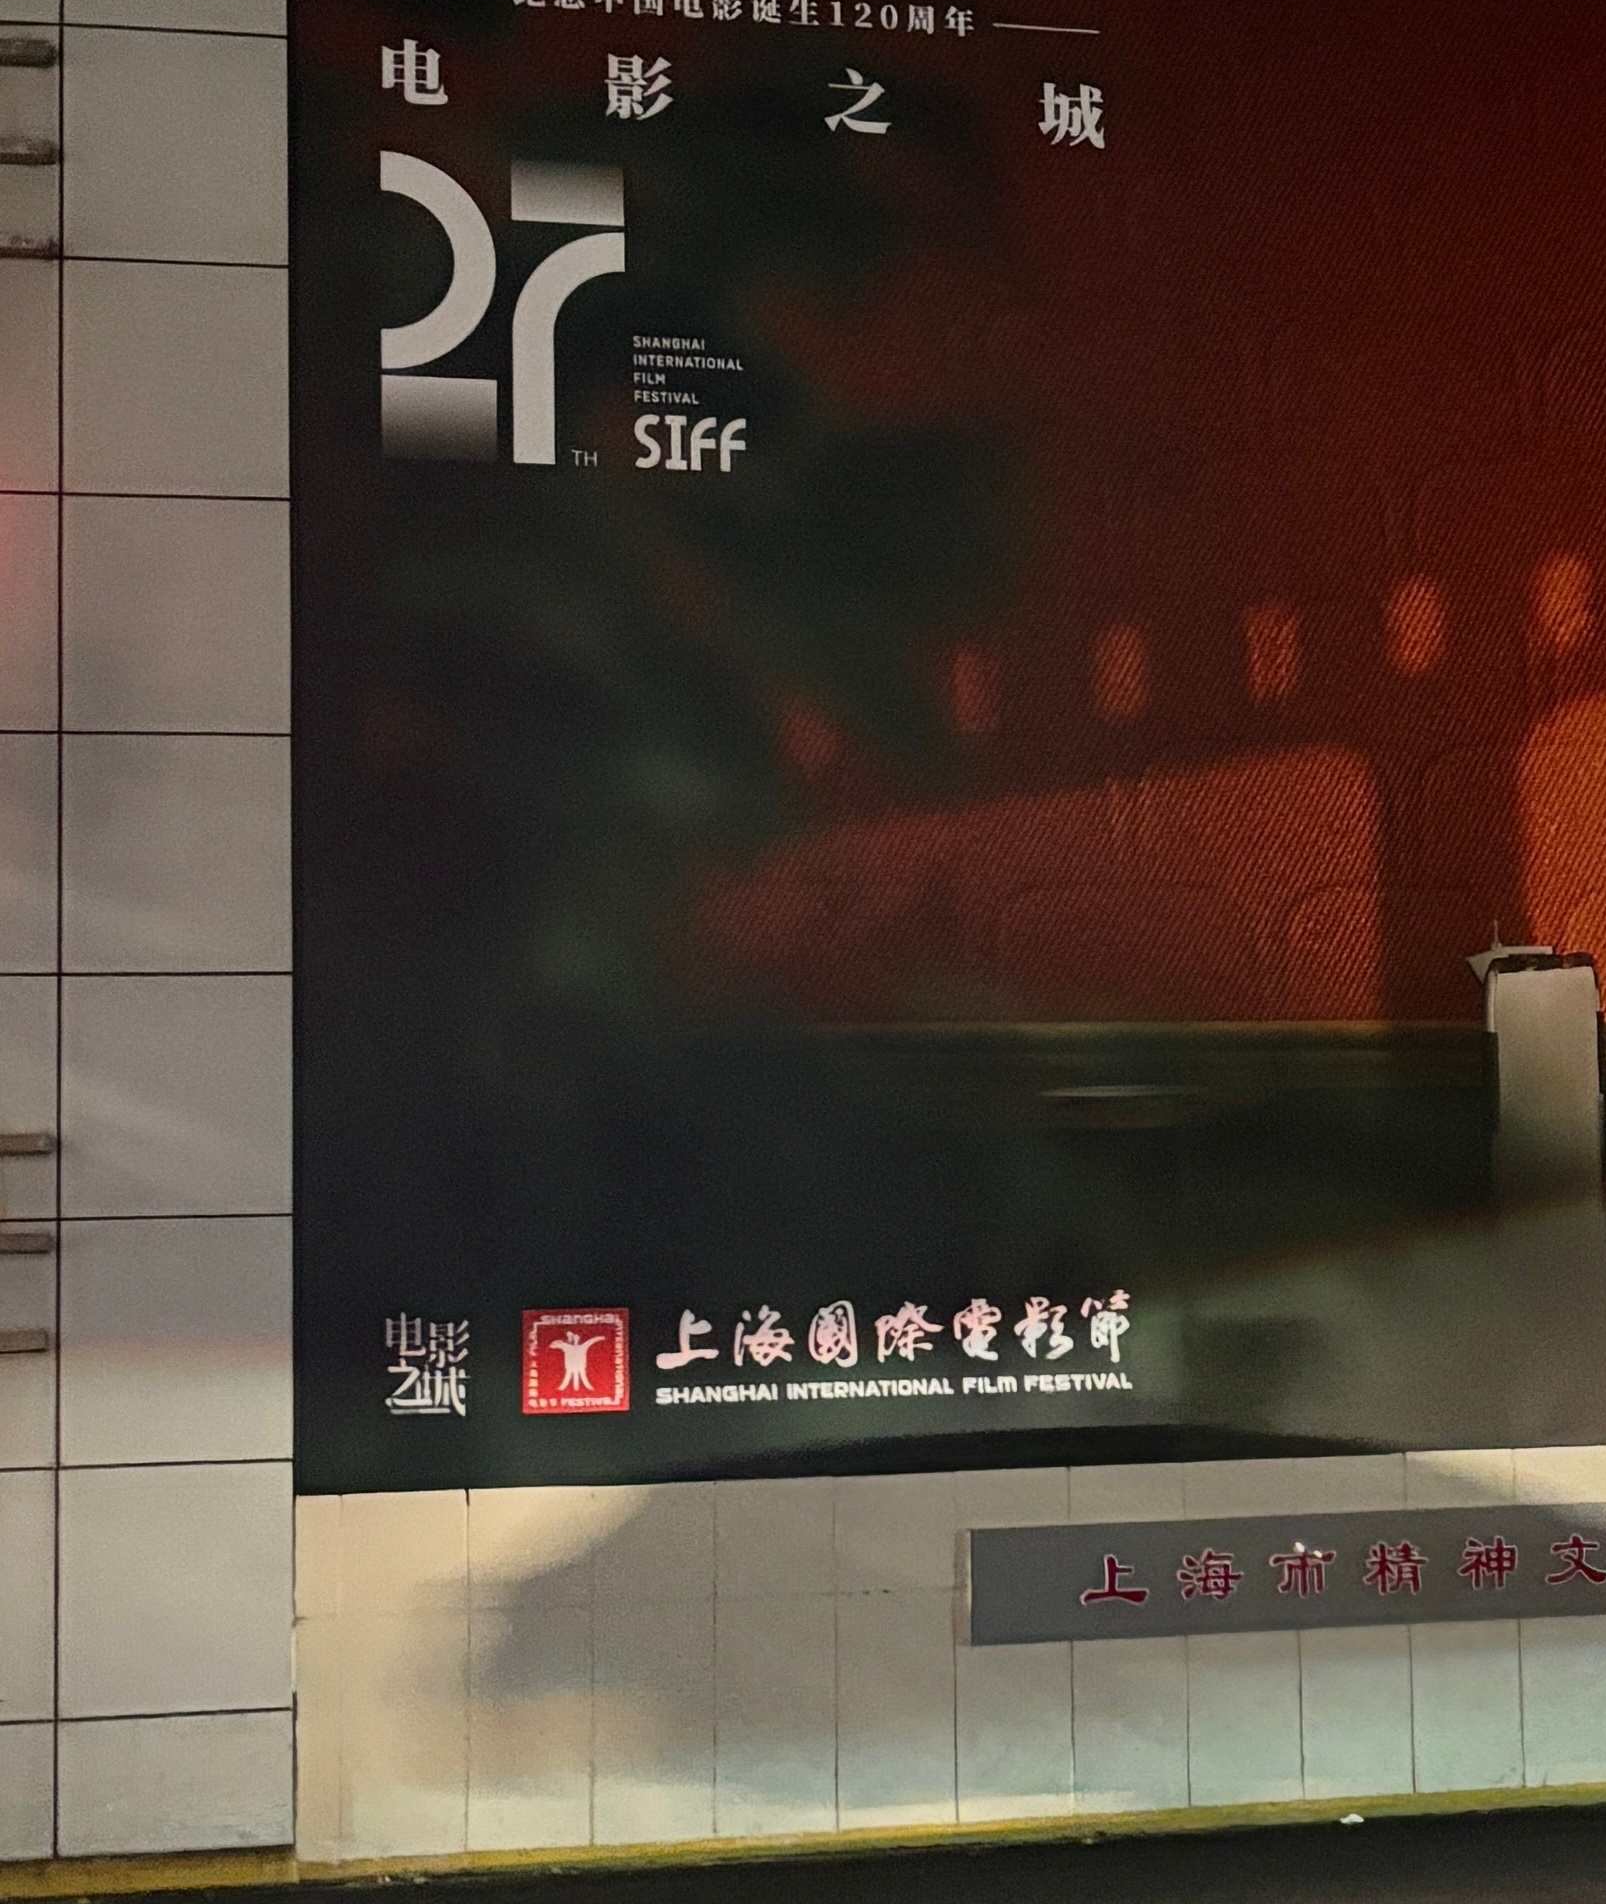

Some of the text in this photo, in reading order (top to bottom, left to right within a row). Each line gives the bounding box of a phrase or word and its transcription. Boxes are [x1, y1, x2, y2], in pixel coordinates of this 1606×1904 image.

[632, 335, 706, 351] SHANGHAI
[632, 354, 744, 372] INTERNATIONAL
[633, 371, 666, 385] FILM
[634, 390, 700, 405] FESTIVAL
[633, 413, 747, 473] SIFF
[571, 449, 598, 468] TH
[655, 1371, 1134, 1405] SHANGHAI INTERNATIONAL FILM FESTIVAL
